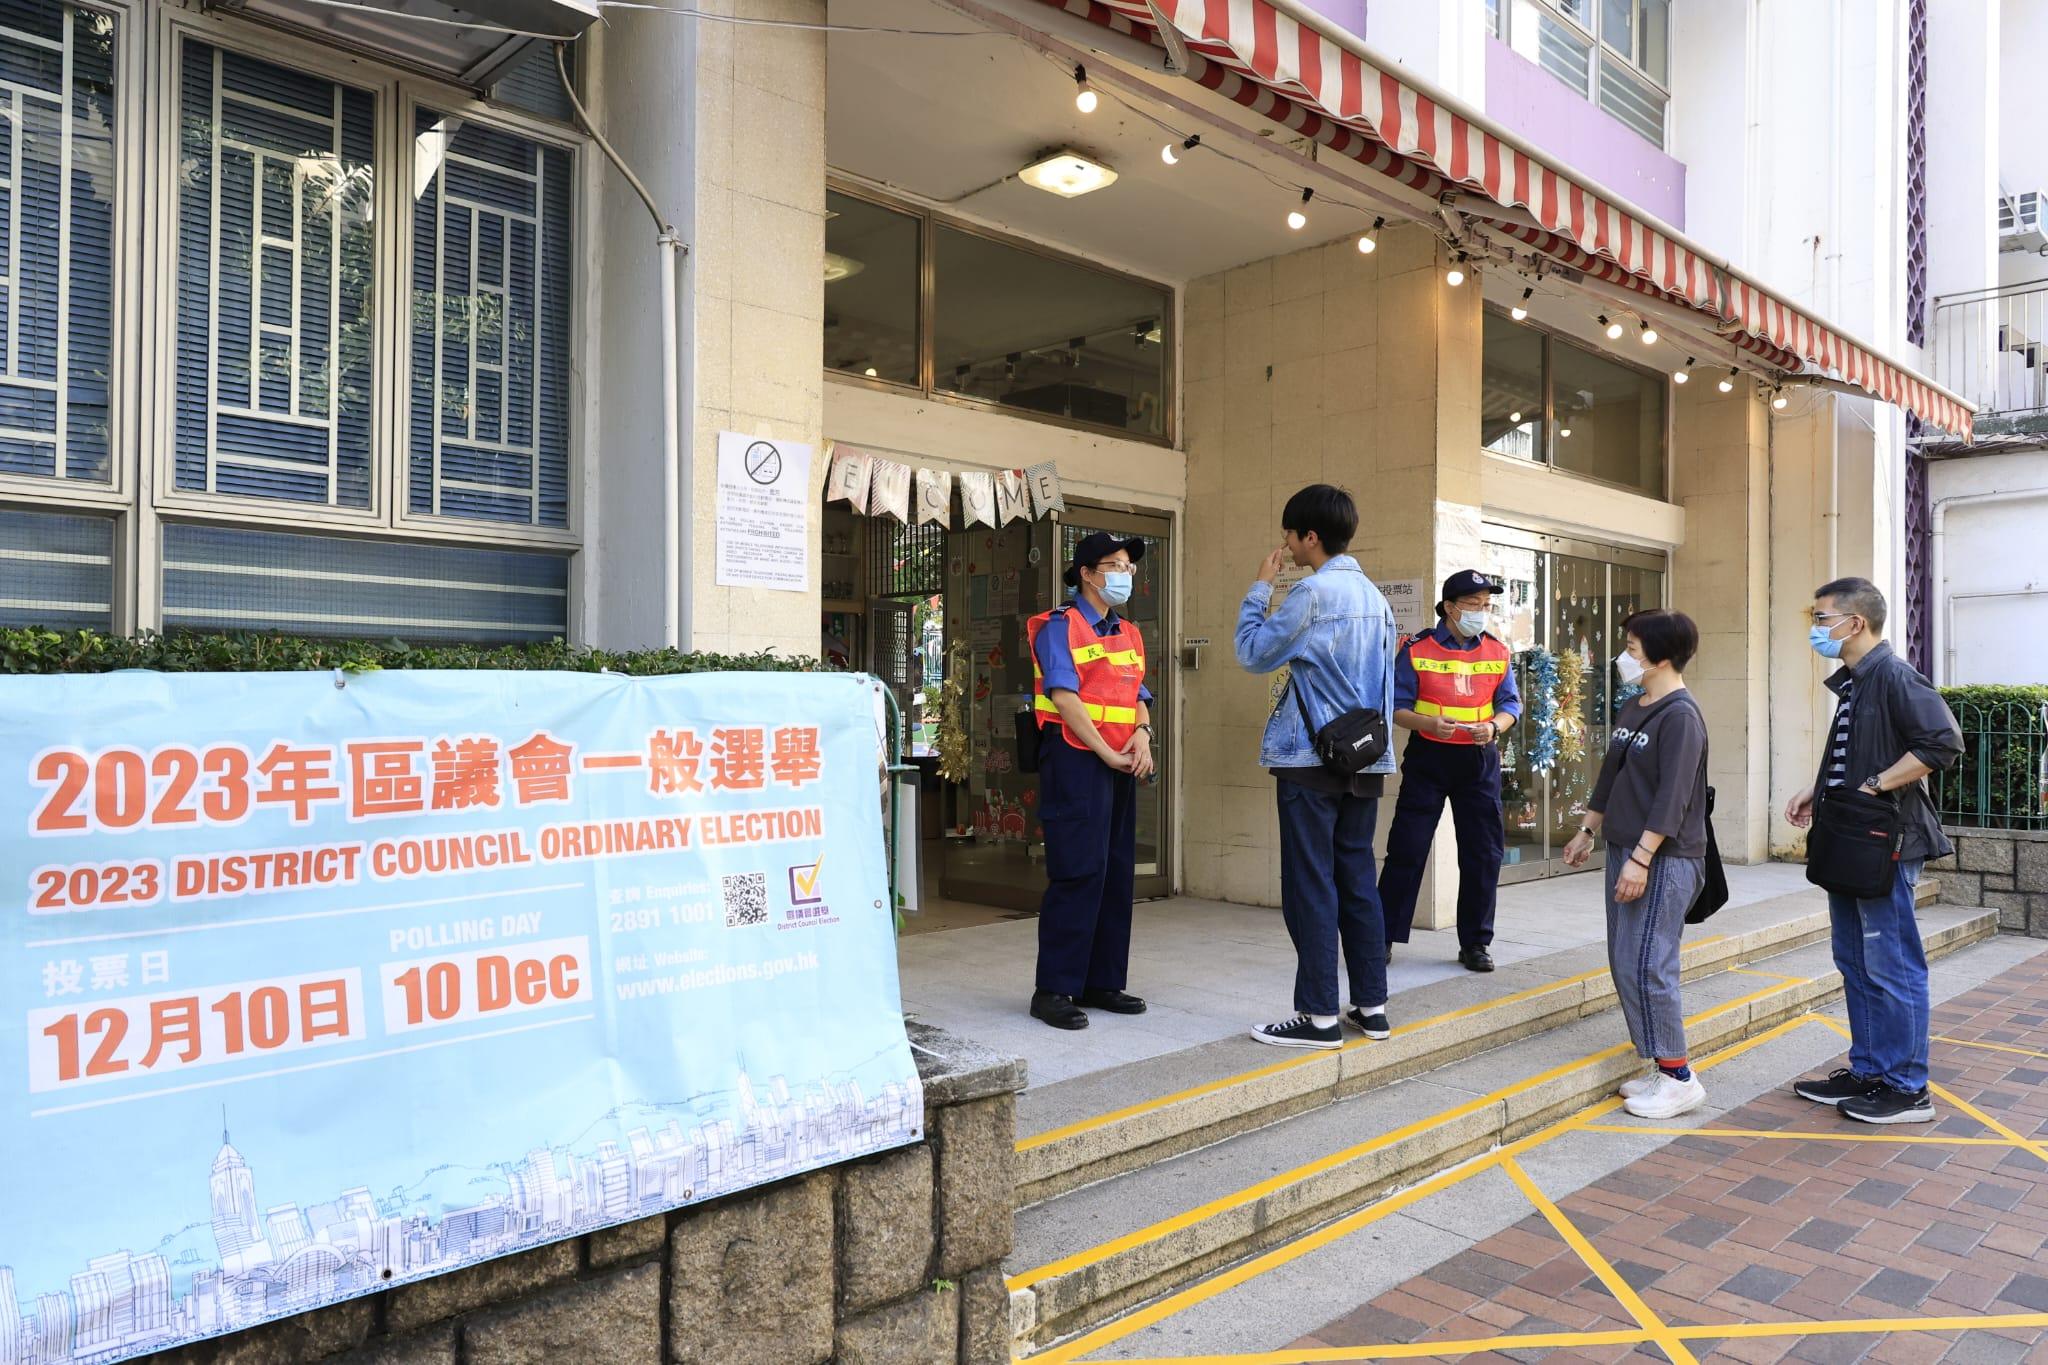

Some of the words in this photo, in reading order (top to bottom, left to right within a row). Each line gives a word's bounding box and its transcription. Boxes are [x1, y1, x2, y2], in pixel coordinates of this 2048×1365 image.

[1377, 583, 1413, 596] 投票站
[1473, 663, 1504, 673] CAS
[36, 727, 822, 831] 2023年區議會一般選舉
[36, 864, 160, 908] 2023
[176, 846, 361, 897] DISTRICT
[373, 831, 532, 877] COUNCIL
[541, 817, 692, 860] ORDINARY
[701, 808, 822, 845] ELECTION
[389, 916, 496, 953] POLLING
[501, 911, 543, 937] DAY
[611, 907, 661, 933] 2891
[669, 901, 713, 925] 1001
[42, 949, 170, 998] 投票日
[394, 961, 461, 1025] 10
[476, 954, 580, 1013] Dec
[616, 950, 820, 1001] www.elections.gov.hk
[43, 978, 350, 1081] 12月10日
